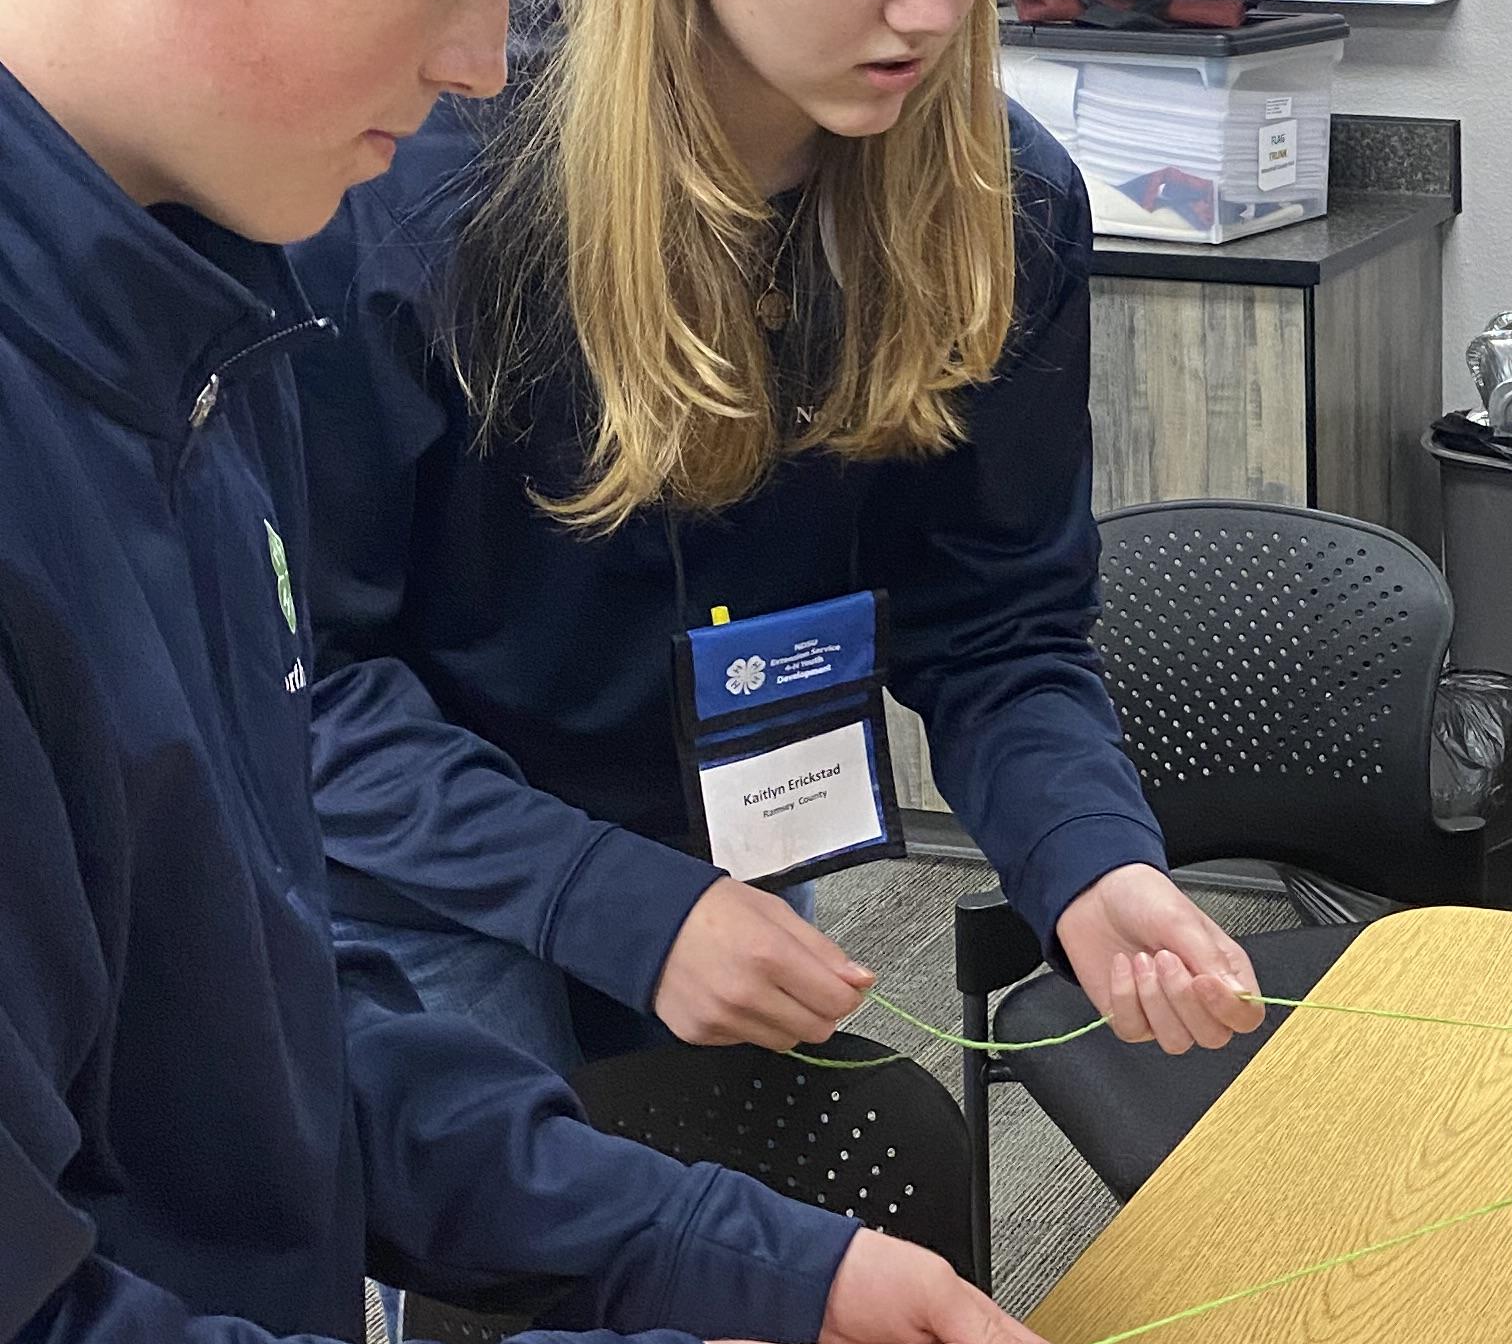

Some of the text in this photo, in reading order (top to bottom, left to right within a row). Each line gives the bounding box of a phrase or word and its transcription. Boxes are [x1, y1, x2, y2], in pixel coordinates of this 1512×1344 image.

[811, 644, 841, 655] Service
[800, 656, 824, 667] Youth
[777, 664, 832, 684] Development
[743, 763, 840, 806] Kaitlyn Erickstad
[798, 790, 827, 805] County
